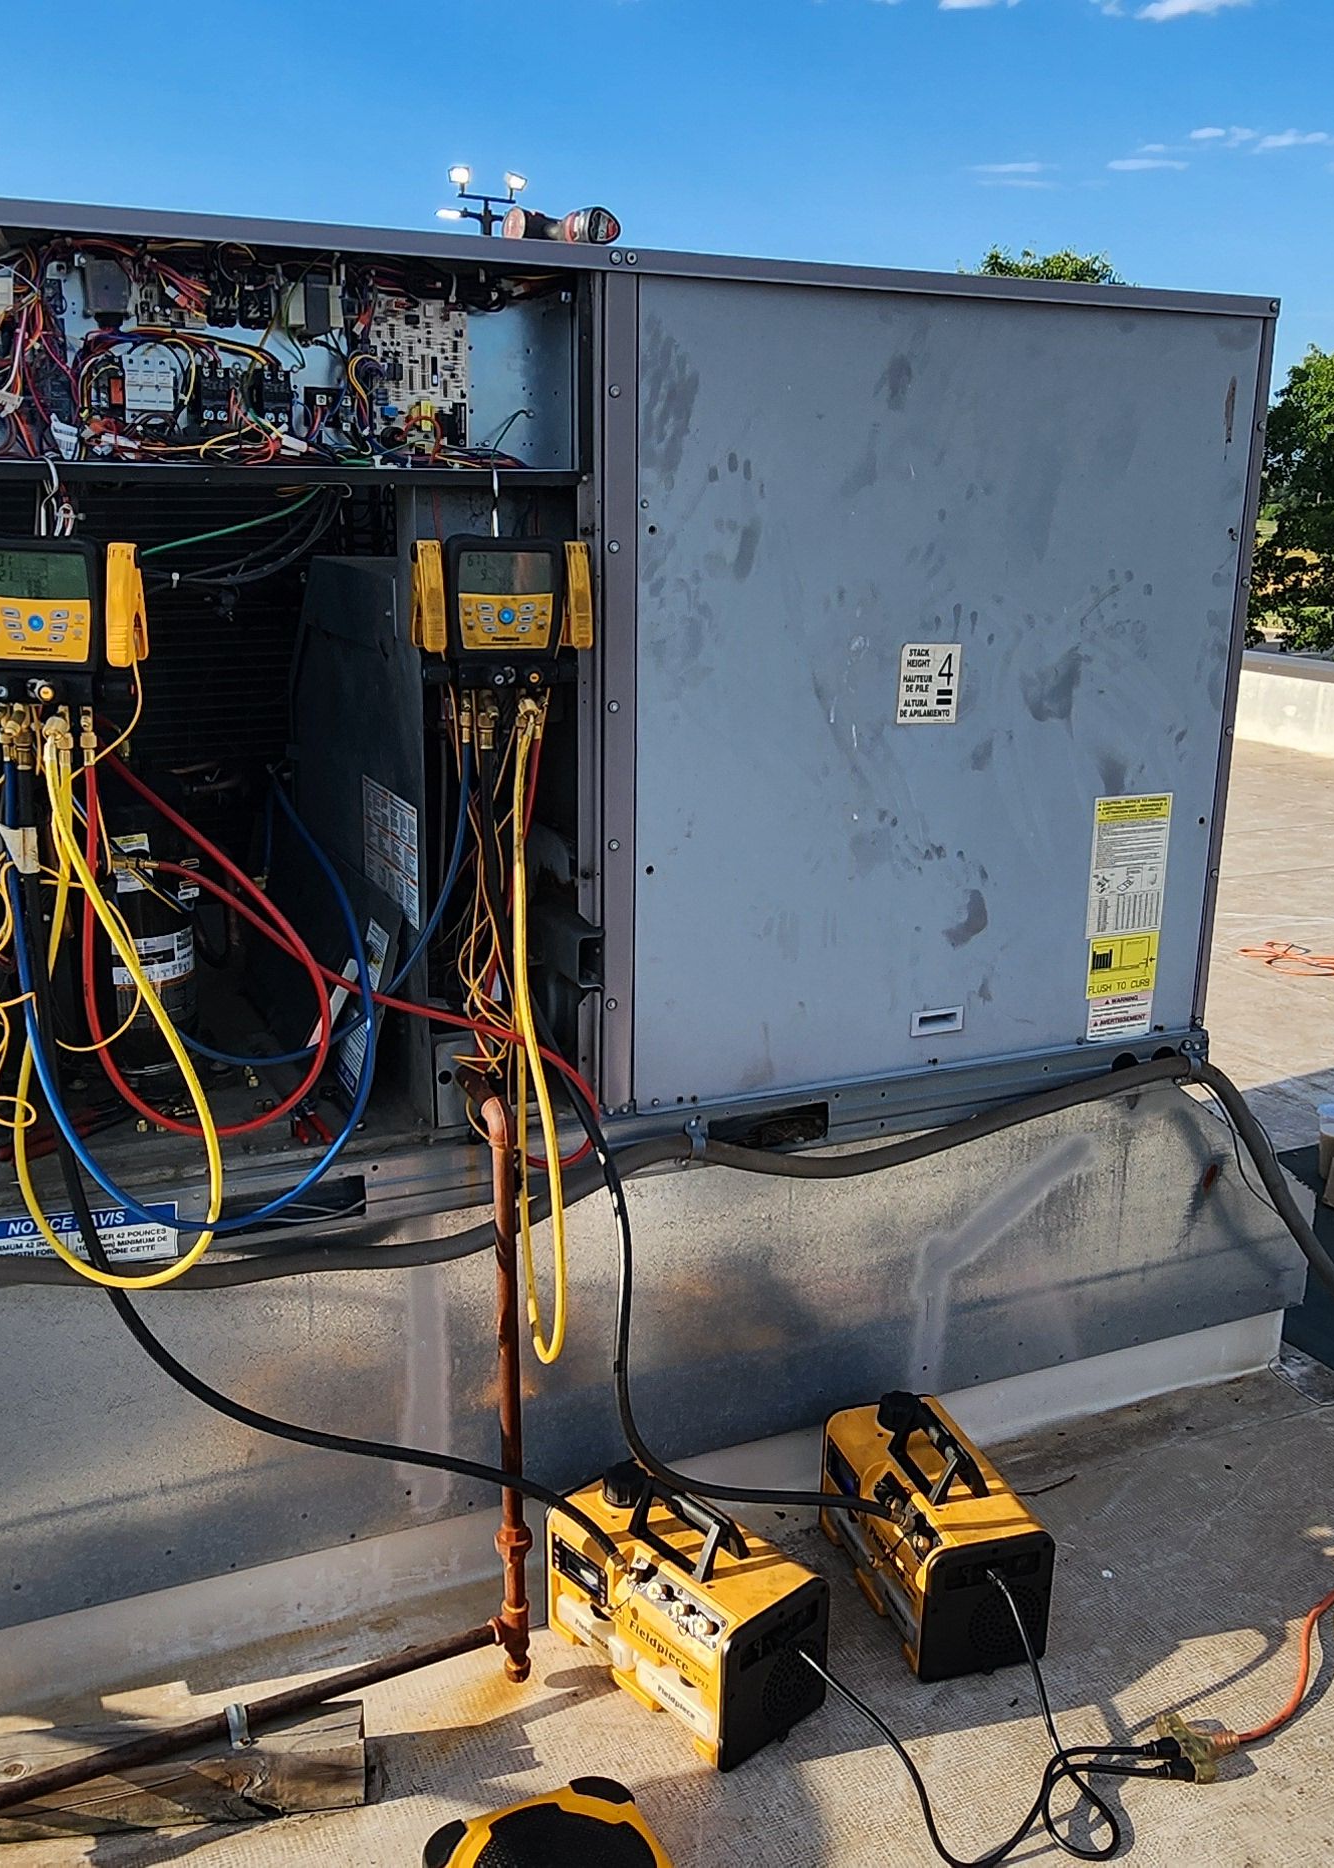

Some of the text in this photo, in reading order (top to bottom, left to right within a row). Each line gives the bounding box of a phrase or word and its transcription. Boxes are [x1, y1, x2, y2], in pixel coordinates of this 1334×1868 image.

[909, 648, 930, 657] STACK
[907, 659, 931, 668] HEIGHT
[937, 652, 954, 687] 4
[903, 674, 933, 683] HAUTEUR
[905, 684, 930, 693] DE PILE
[903, 699, 928, 707] ALTURA
[899, 709, 950, 718] DE APILAMIENTO
[1088, 984, 1112, 994] FLUSH
[1116, 981, 1127, 990] TO
[1111, 995, 1138, 1004] WARNING
[1100, 1013, 1146, 1025] AVERTISSEMENT
[7, 1216, 73, 1236] NOCE
[127, 1228, 167, 1238] POUNCES
[117, 1236, 155, 1247] MINIMUM
[129, 1245, 156, 1253] CETTE
[628, 1619, 689, 1673] Fieldpiece
[657, 1684, 695, 1720] Fieldpiece
